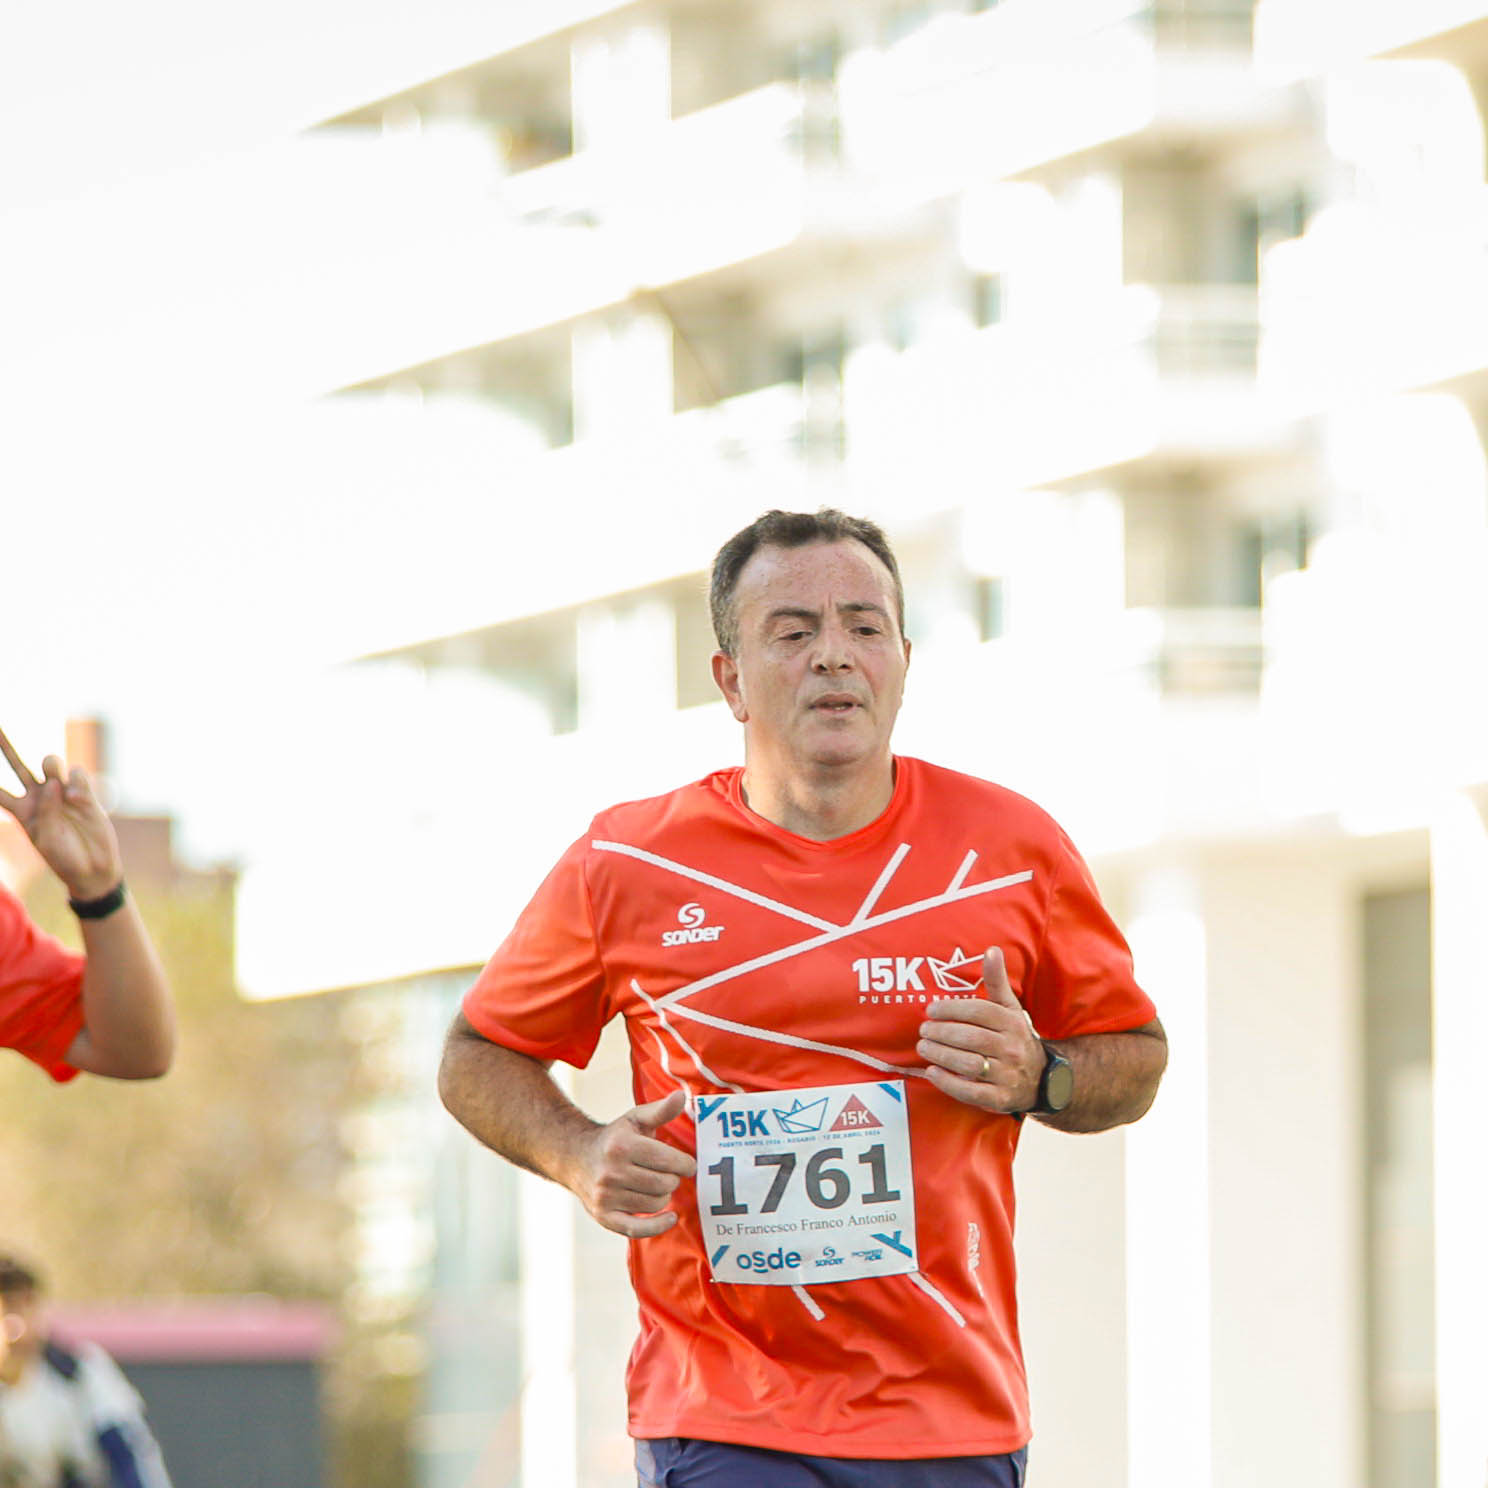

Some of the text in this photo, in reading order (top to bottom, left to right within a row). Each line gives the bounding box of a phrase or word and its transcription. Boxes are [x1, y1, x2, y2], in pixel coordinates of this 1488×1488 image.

[852, 956, 926, 992] 15K
[858, 994, 927, 1004] PUERTO
[717, 1109, 771, 1138] 15K
[840, 1110, 871, 1126] 15K
[708, 1143, 901, 1216] 1761
[716, 1211, 897, 1236] De Francesco Franco Antonio
[736, 1247, 801, 1273] osde
